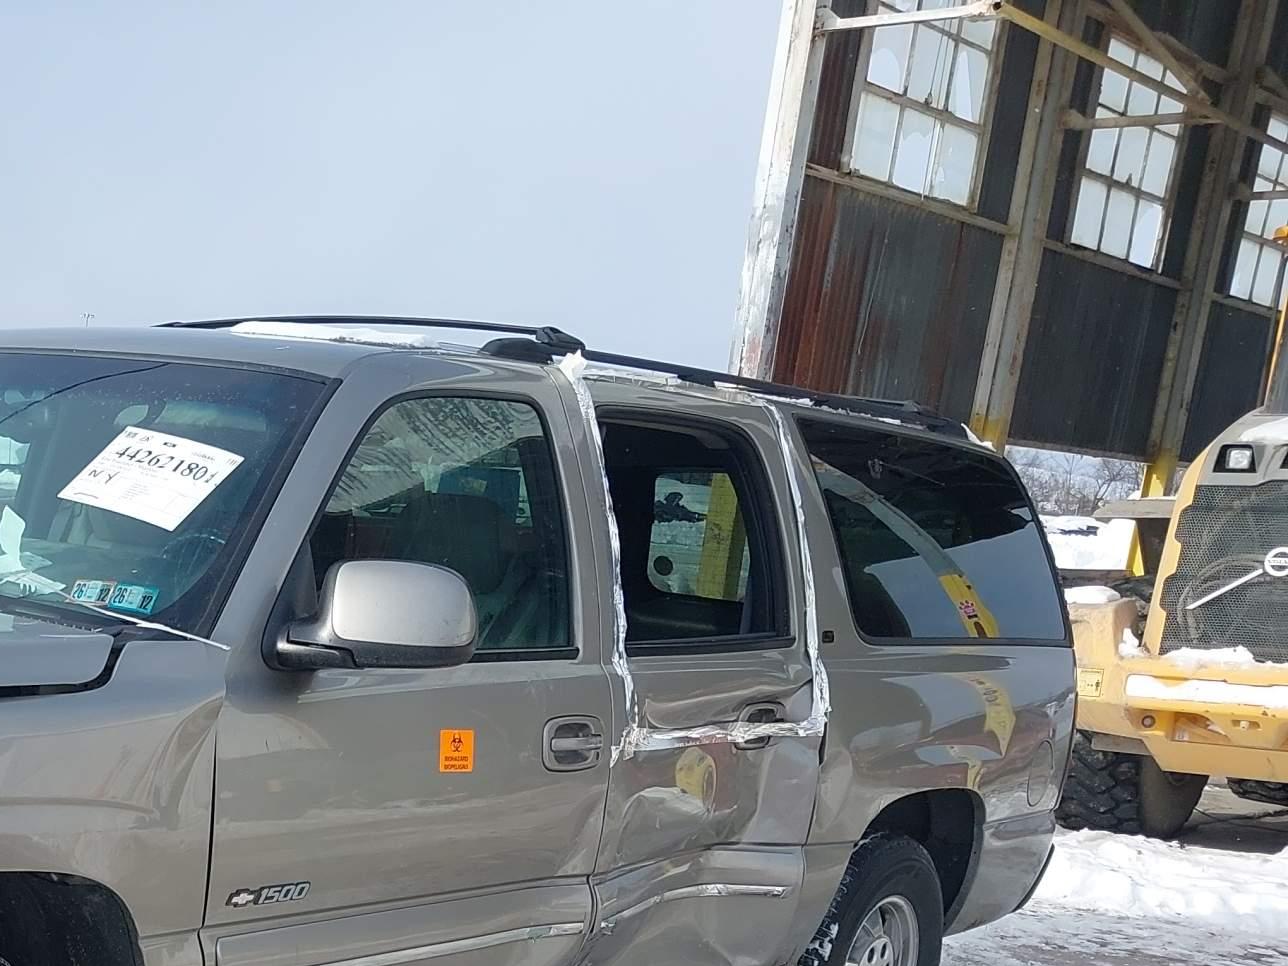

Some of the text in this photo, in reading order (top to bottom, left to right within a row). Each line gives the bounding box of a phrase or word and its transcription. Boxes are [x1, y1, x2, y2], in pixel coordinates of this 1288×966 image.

[115, 446, 208, 480] 44262180
[73, 582, 87, 599] 26
[97, 588, 111, 601] 12
[112, 587, 128, 604] 26
[139, 594, 153, 609] 12
[258, 882, 310, 905] 1500
